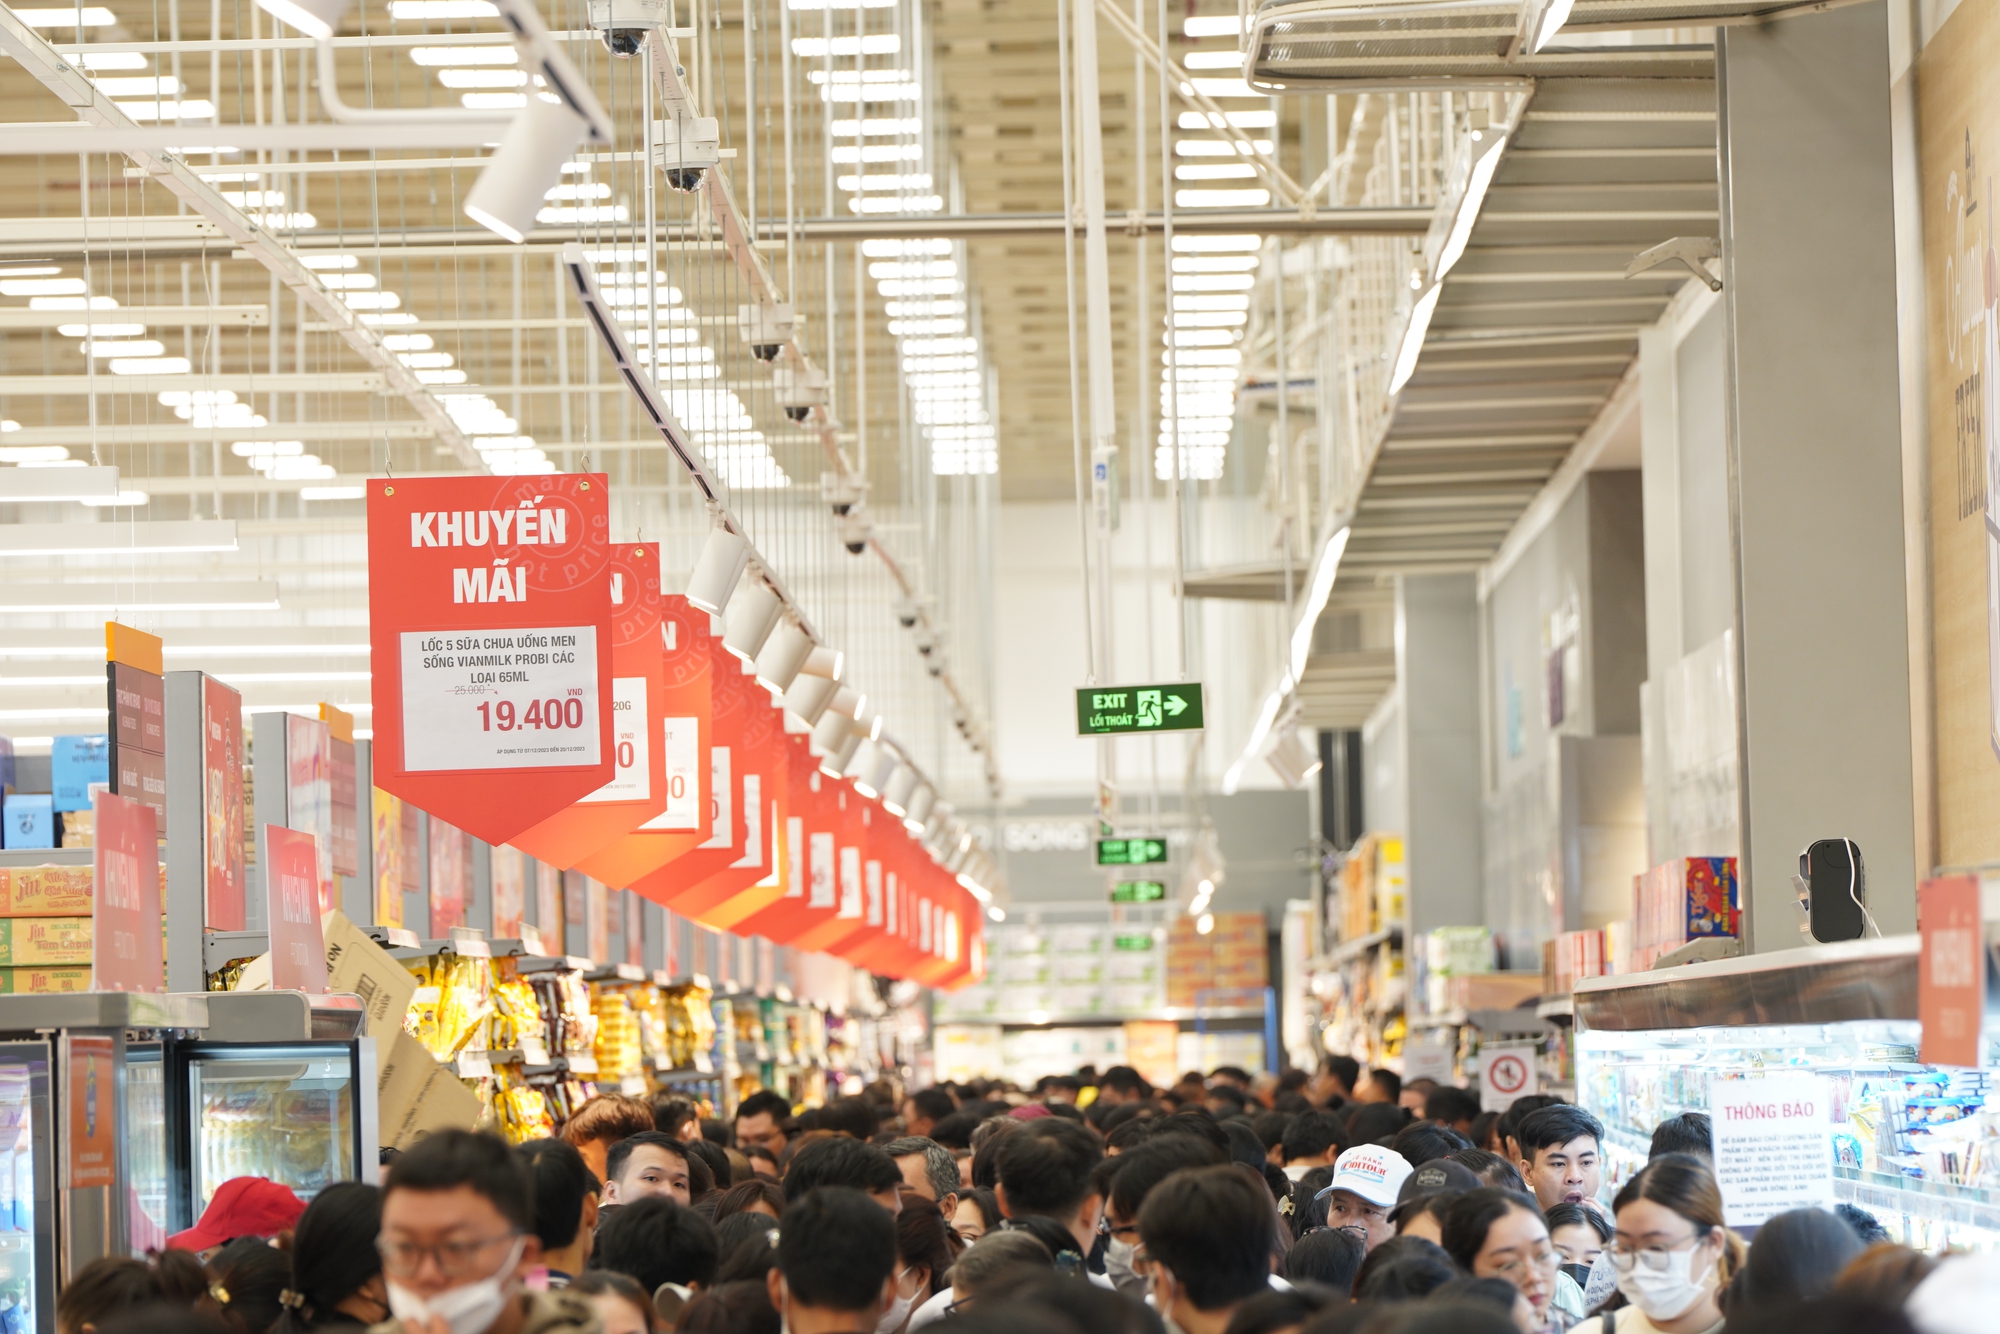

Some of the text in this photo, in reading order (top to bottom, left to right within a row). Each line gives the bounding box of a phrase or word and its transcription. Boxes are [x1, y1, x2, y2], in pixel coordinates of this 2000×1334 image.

[1955, 371, 1983, 520] FRESH
[411, 495, 566, 548] KHUYẾN
[563, 514, 608, 586] price
[453, 558, 527, 604] MÃI
[421, 634, 576, 652] LỐC 5 SỮA CHUA UỐNG MEN
[423, 652, 575, 669] SỐNG VIANMILK PROBI CÁC
[470, 671, 529, 687] LOẠI 65ML
[567, 688, 583, 696] VND
[1092, 694, 1127, 709] EXIT
[476, 698, 584, 732] 19.400
[1089, 712, 1133, 727] LỐI THOÁT
[1690, 879, 1709, 916] Tiger
[1724, 1098, 1814, 1120] THÔNG BÁO
[1363, 1155, 1383, 1167] HÀNH
